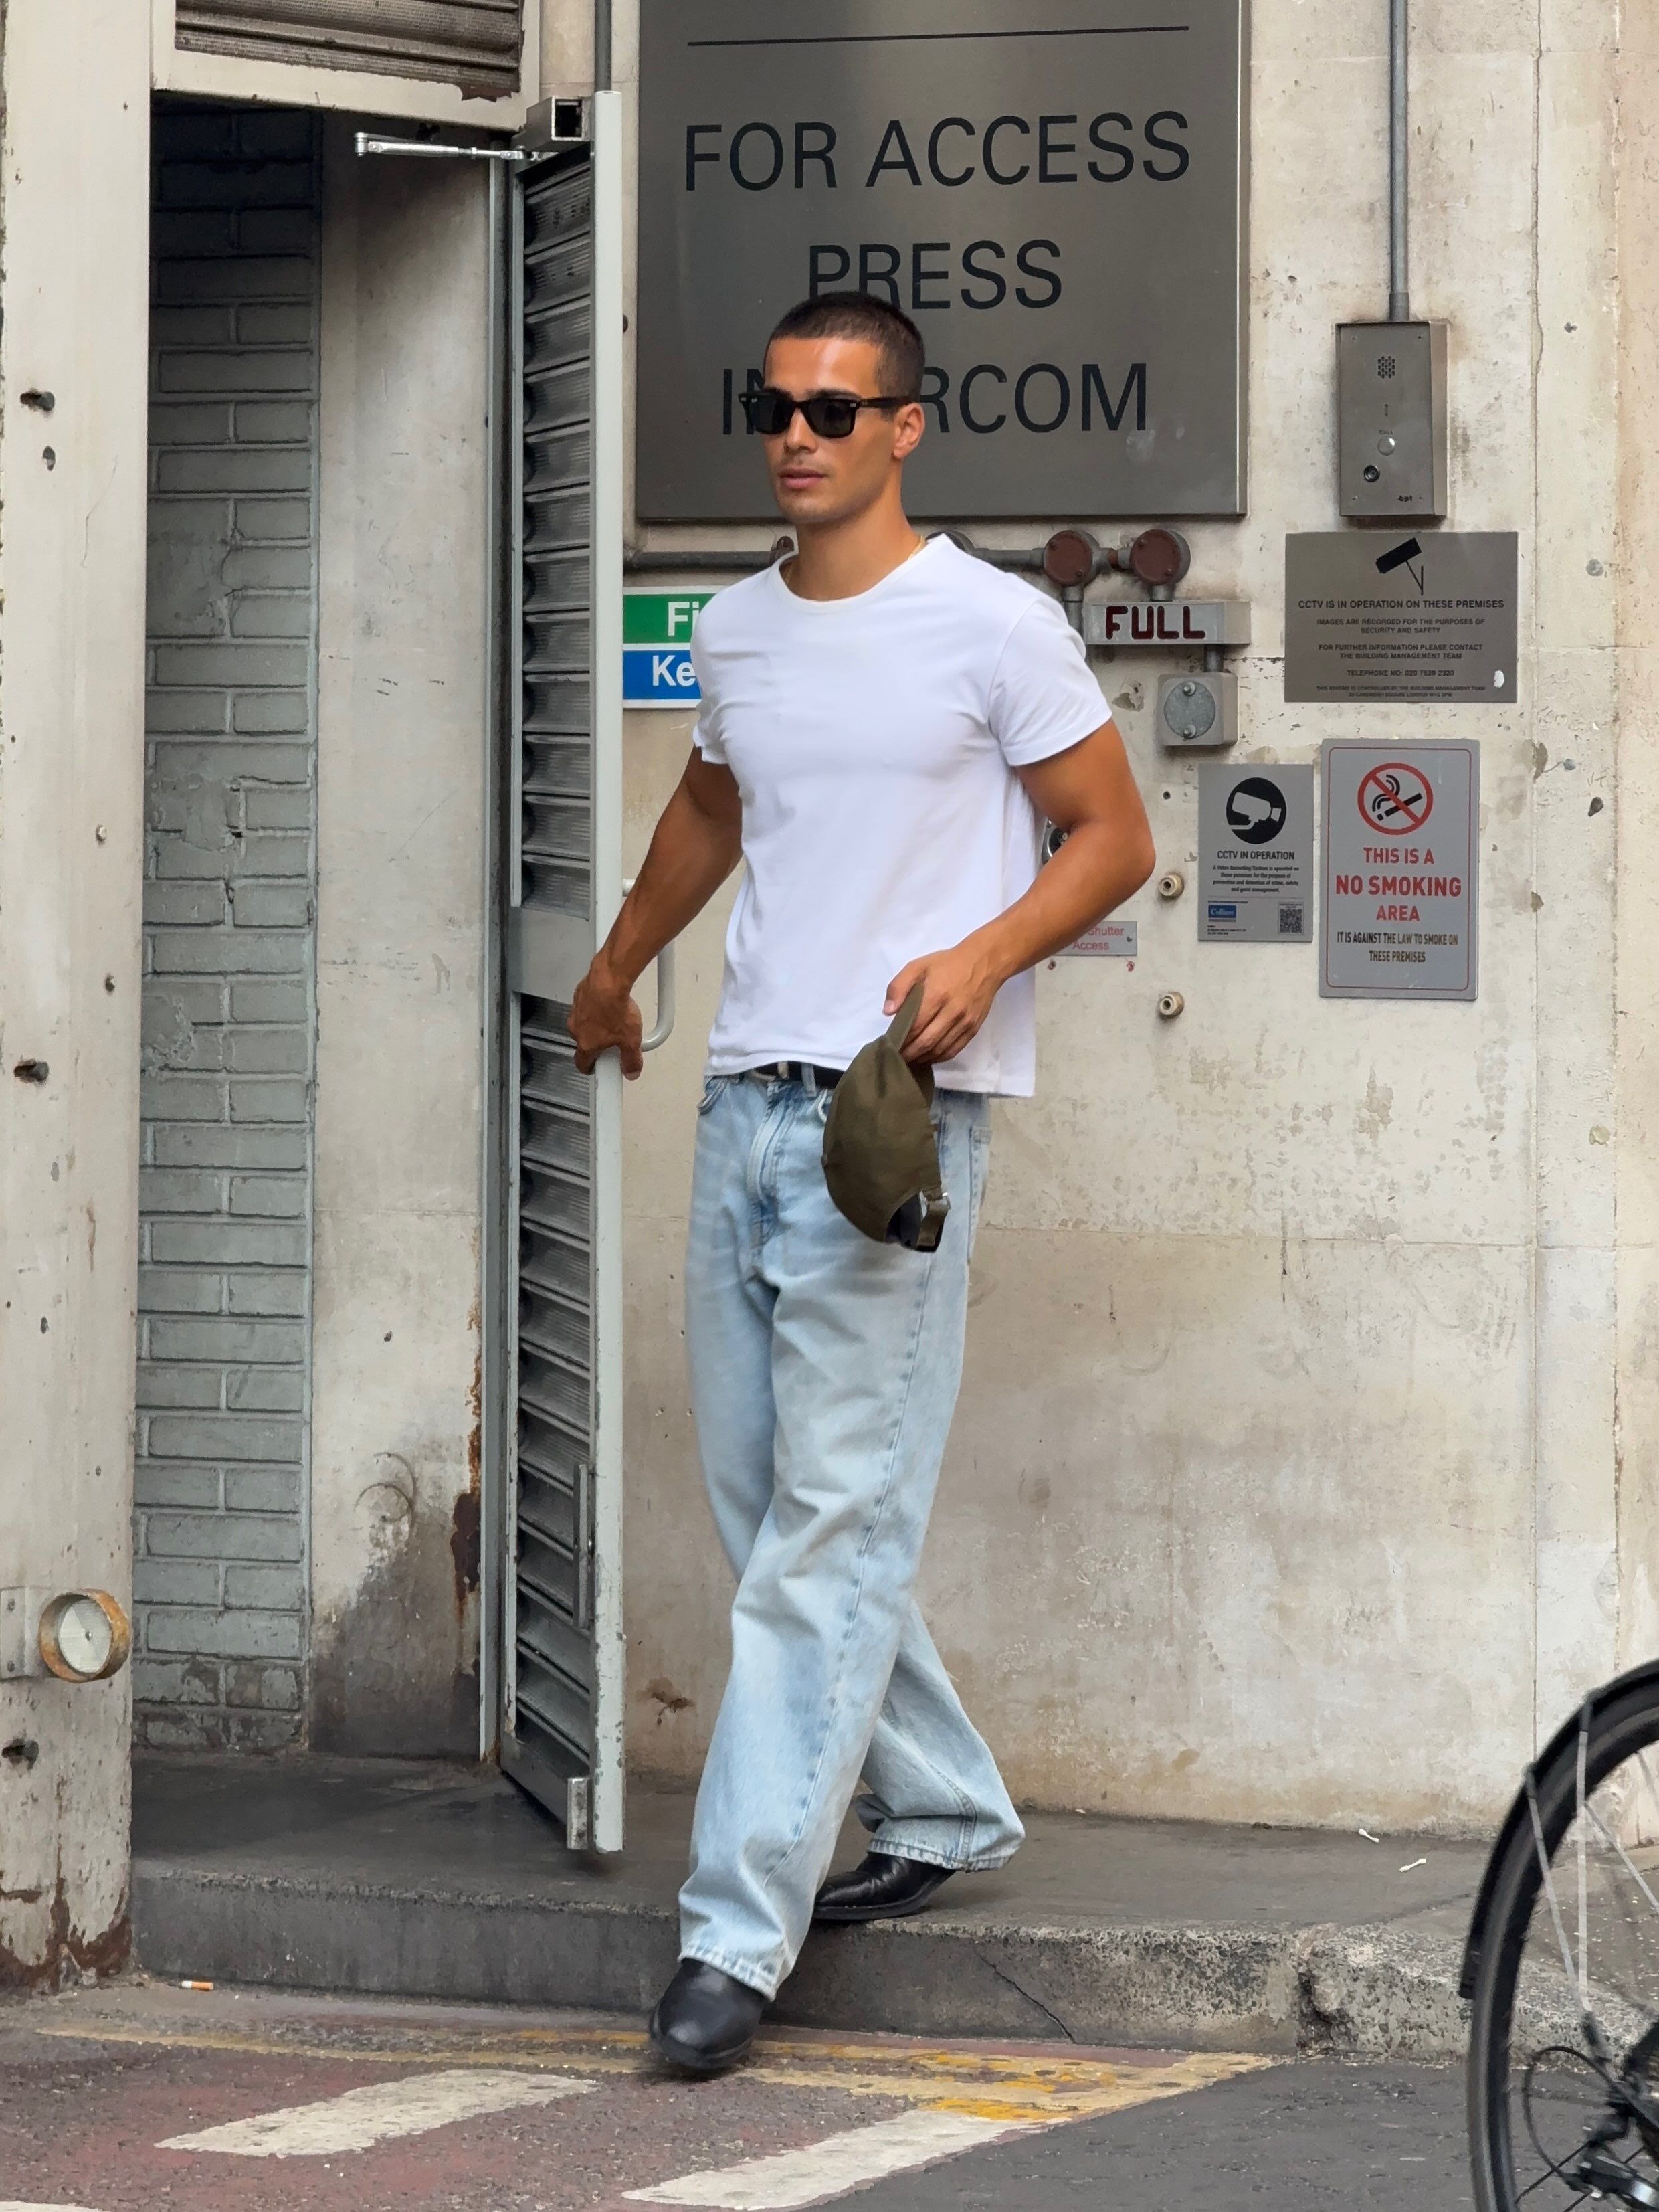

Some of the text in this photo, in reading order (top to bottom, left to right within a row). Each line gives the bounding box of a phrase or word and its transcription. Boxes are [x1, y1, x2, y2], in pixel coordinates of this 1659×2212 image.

[686, 110, 1190, 191] FOR ACCESS
[809, 239, 1062, 310] PRESS
[1298, 600, 1504, 609] CCTV IS IN OPERATION ON THESE PREMISES
[668, 602, 699, 636] Fi
[1105, 605, 1206, 640] FULL
[653, 655, 696, 687] Ke
[1217, 850, 1294, 860] CCTV IN OPERATION
[1363, 847, 1434, 864] THIS IS A
[1336, 874, 1462, 897] NO SMOKING
[1376, 905, 1420, 921] AREA
[1087, 927, 1125, 936] Shutter
[1337, 931, 1458, 946] IT IS AGAINST THE LAW TO SMOKE ON
[1072, 941, 1110, 950] Access
[1369, 950, 1426, 963] THESE PREMISES
